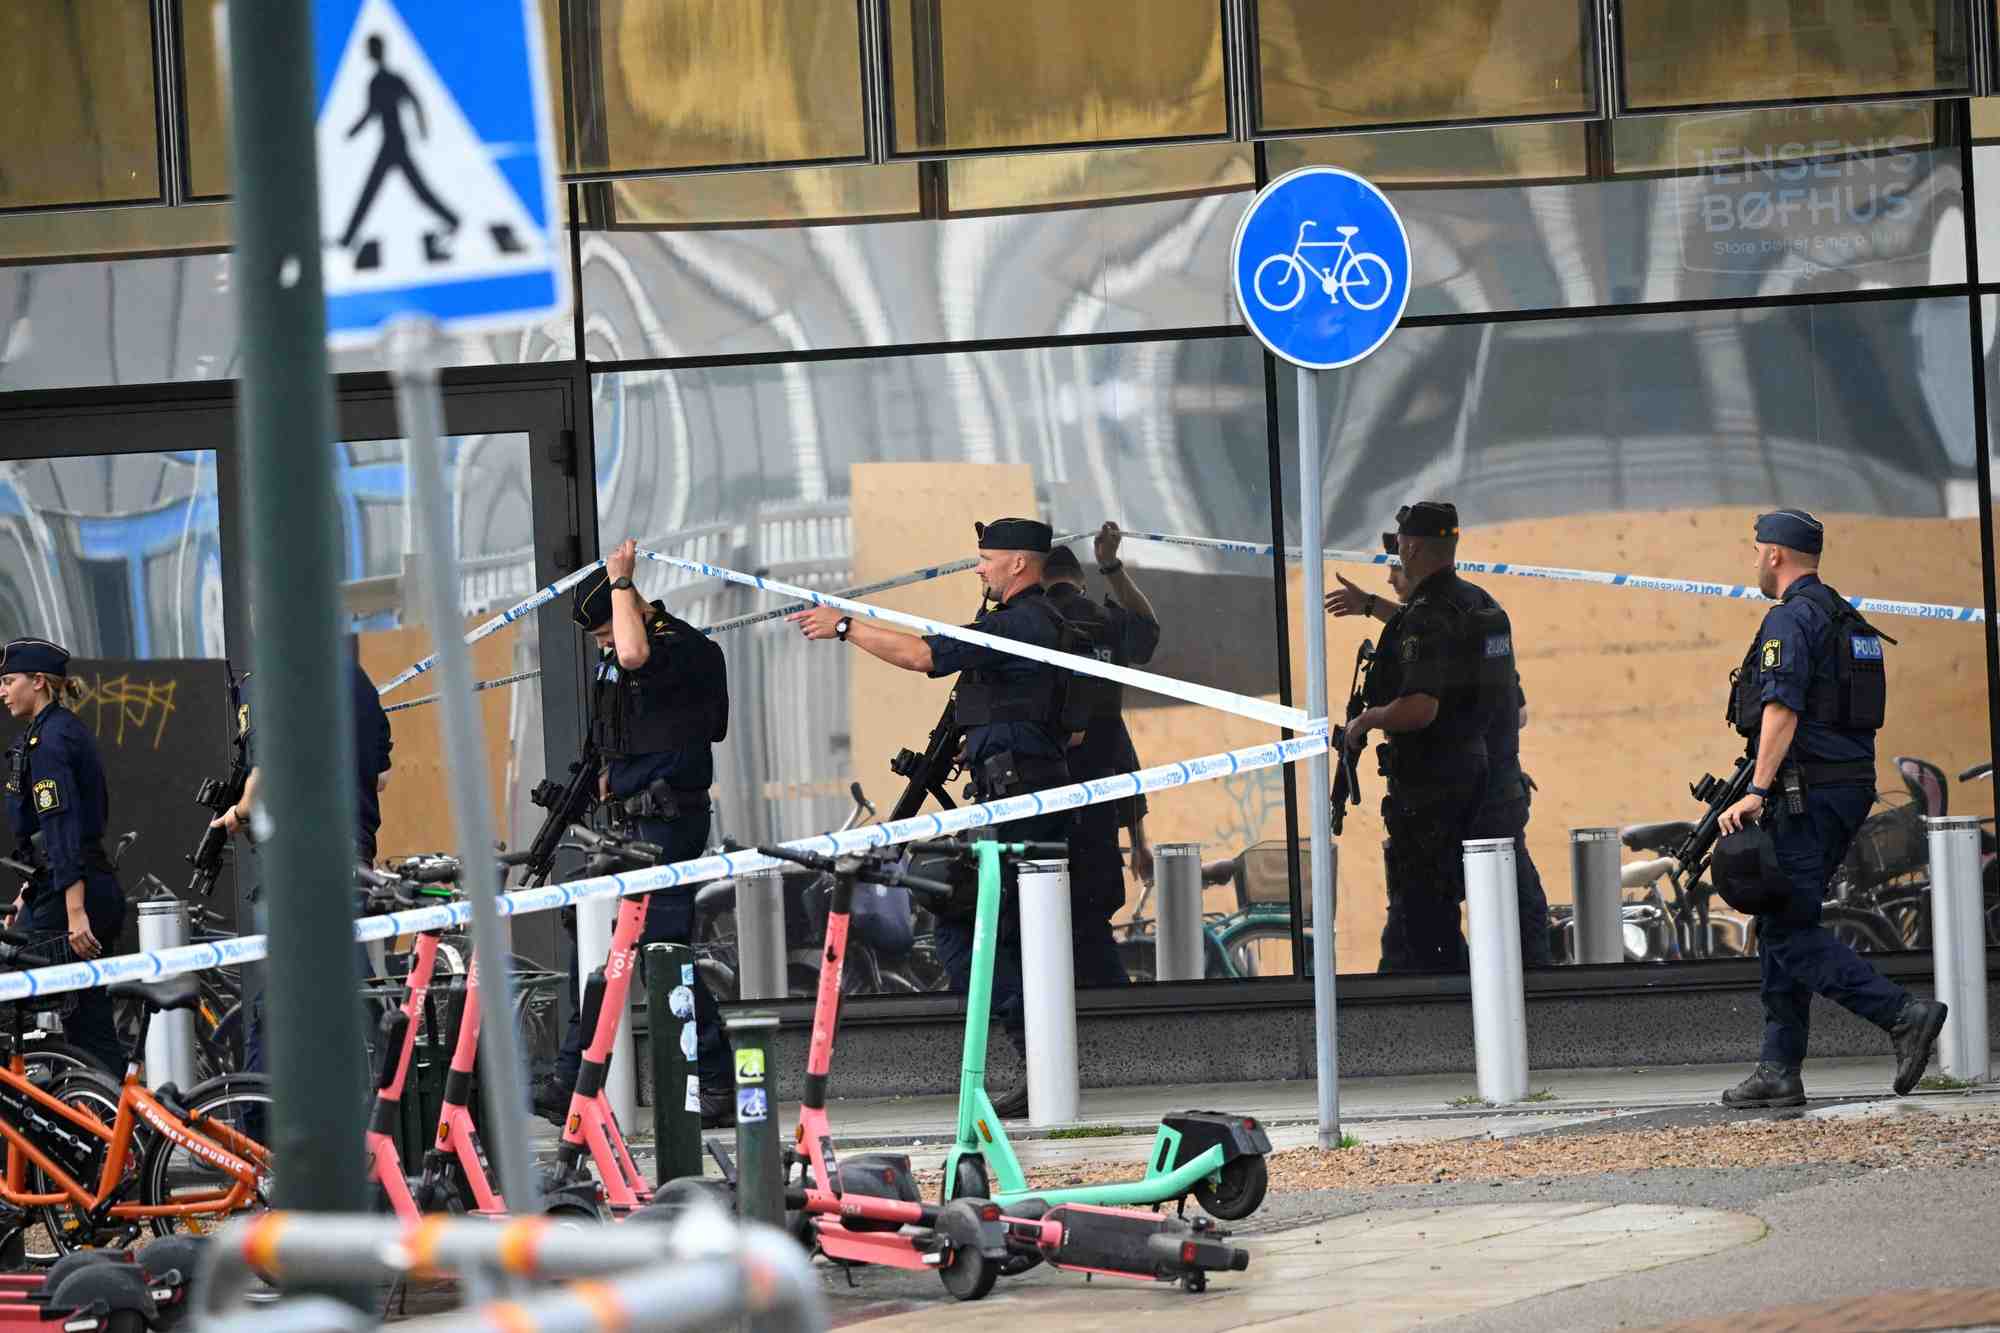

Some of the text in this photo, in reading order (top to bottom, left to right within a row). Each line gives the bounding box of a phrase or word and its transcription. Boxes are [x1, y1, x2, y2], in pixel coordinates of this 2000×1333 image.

[1702, 183, 1913, 234] BØFHUS
[1854, 639, 1881, 656] POLIS
[145, 1108, 245, 1173] DONKEY REPUBLIC
